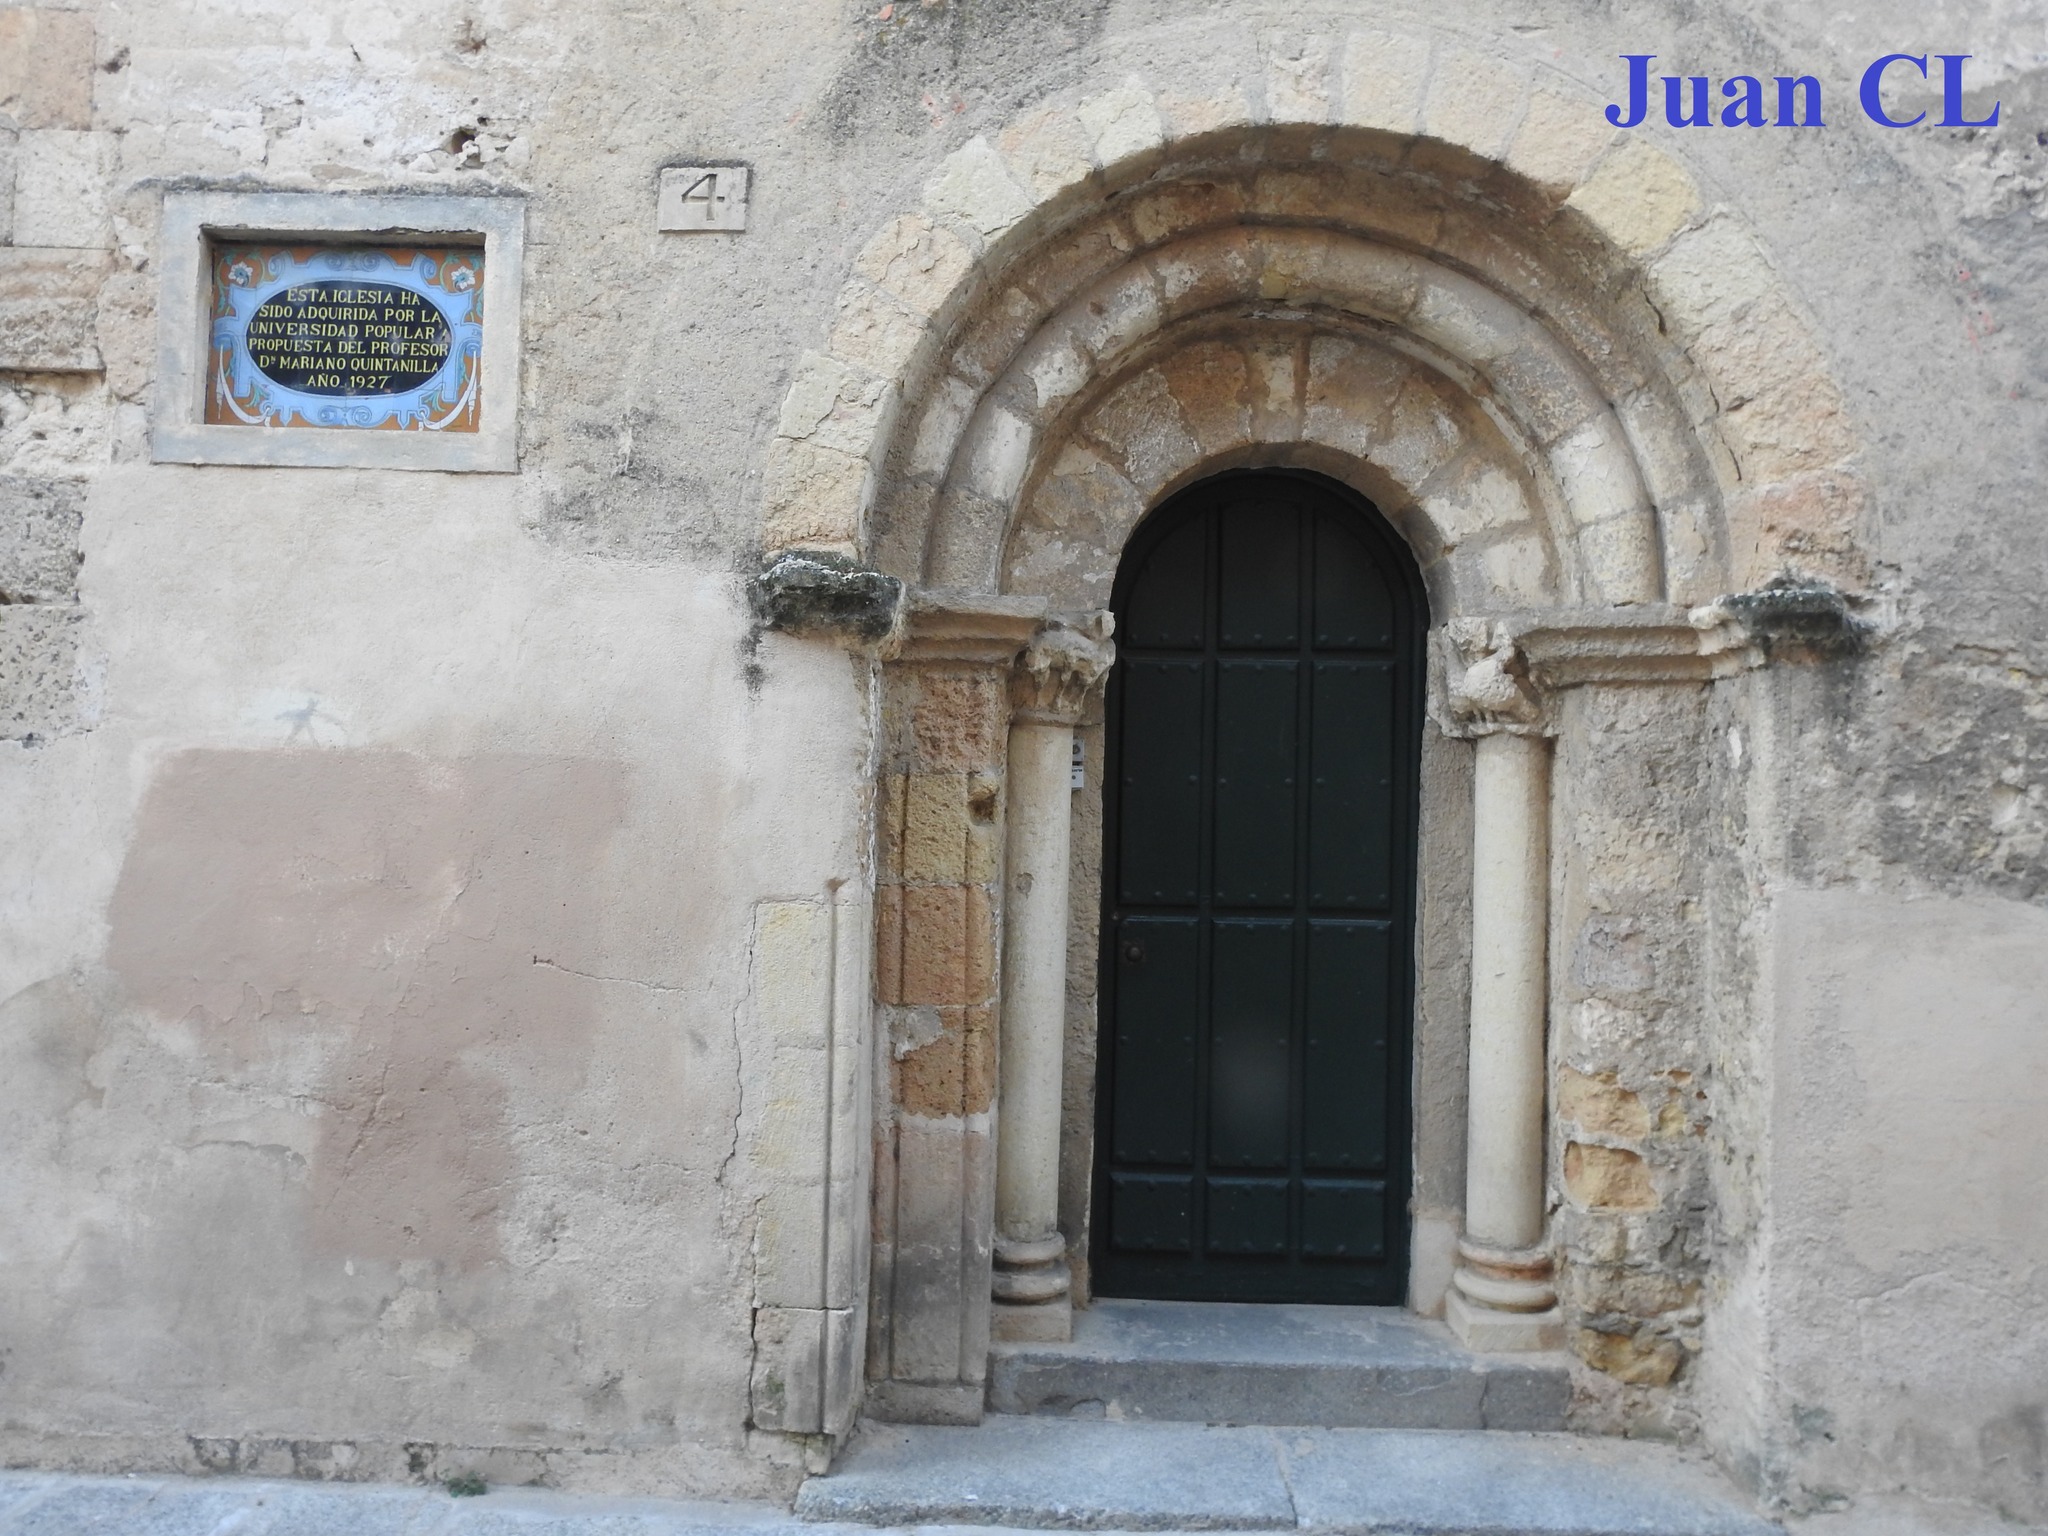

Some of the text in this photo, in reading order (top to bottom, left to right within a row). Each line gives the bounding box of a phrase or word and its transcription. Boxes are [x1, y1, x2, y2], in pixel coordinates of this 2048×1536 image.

[681, 174, 725, 221] 4
[287, 288, 419, 305] ESTA IGLESIA HA
[260, 306, 441, 323] SIDO ADQUIRIDA POR LA
[250, 322, 358, 337] UNIVERSIDAD
[365, 325, 435, 340] POPULAR
[249, 338, 448, 356] PROPUESTA DEL PROFESOR
[280, 357, 345, 370] MARIANO
[351, 359, 439, 373] QUINTANILLA
[307, 373, 391, 389] AÑO 1927
